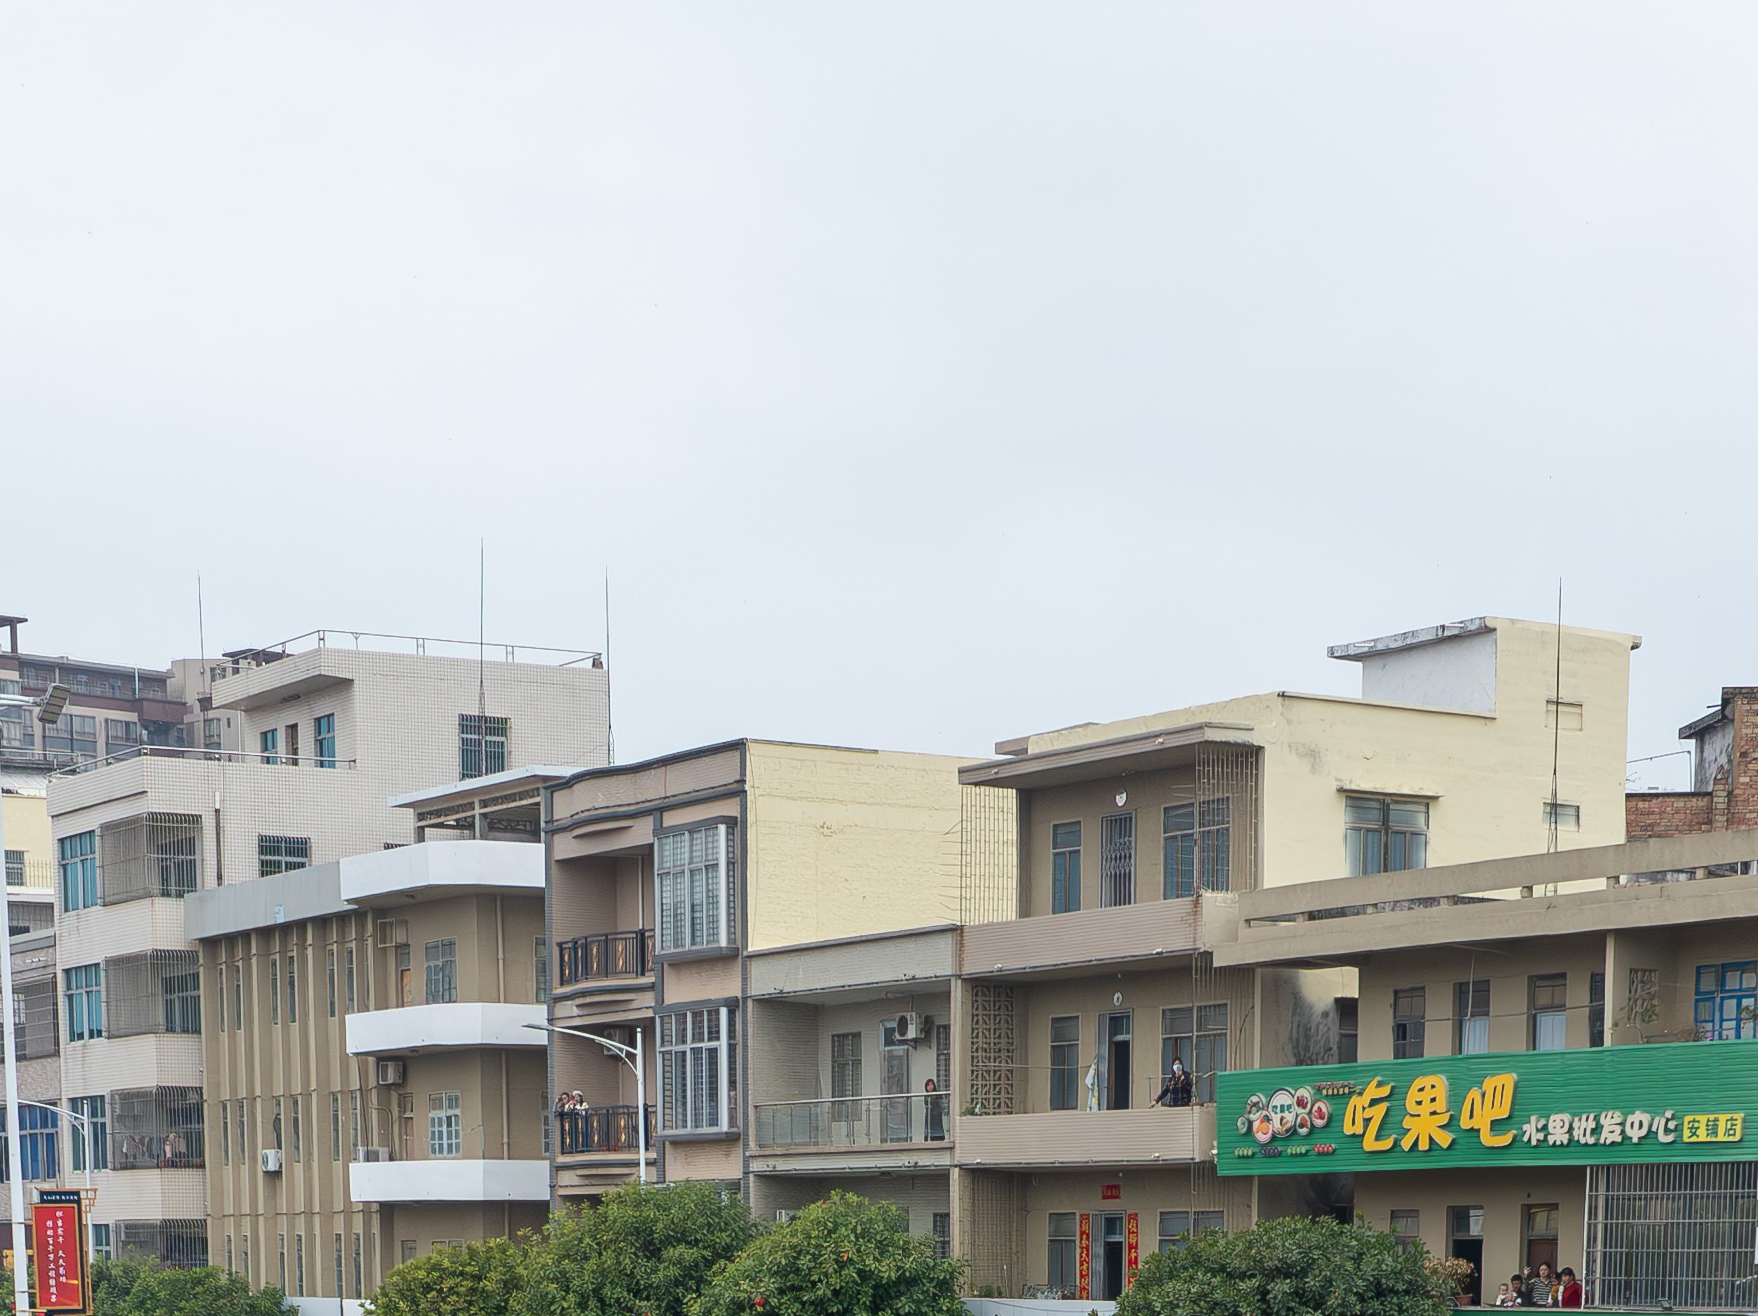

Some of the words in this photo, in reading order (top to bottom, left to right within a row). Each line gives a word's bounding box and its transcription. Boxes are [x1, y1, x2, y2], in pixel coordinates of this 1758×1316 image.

[1342, 1073, 1518, 1153] 吃果吧
[1522, 1110, 1677, 1146] 水果批发中心
[1686, 1116, 1739, 1140] 安铺店
